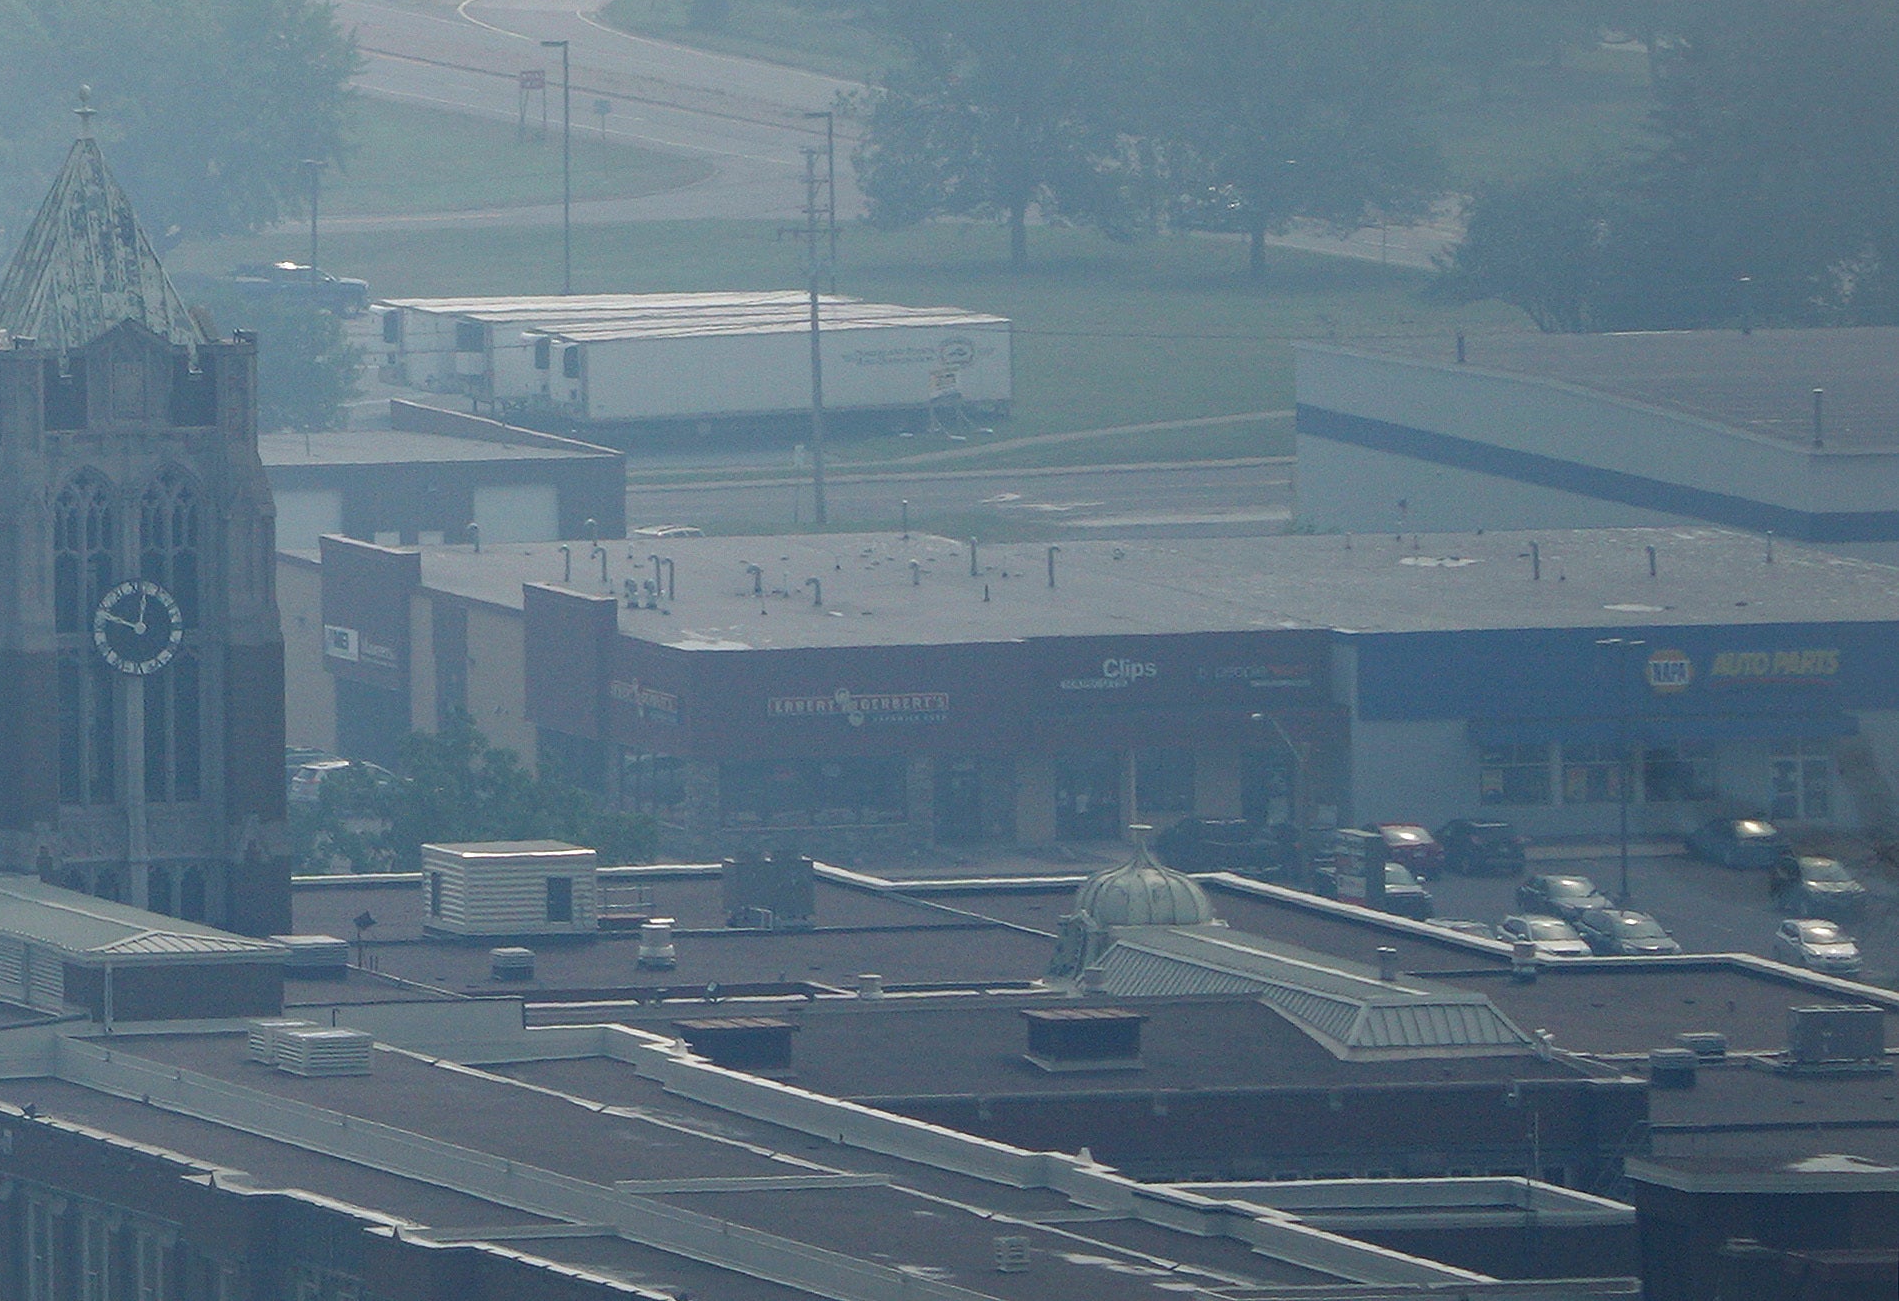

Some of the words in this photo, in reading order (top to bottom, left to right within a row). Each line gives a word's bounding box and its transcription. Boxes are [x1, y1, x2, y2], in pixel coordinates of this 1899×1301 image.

[1102, 657, 1158, 682] Clips
[1653, 662, 1689, 683] NAPA
[1711, 652, 1770, 676] AUTO
[1772, 650, 1840, 676] PARTS
